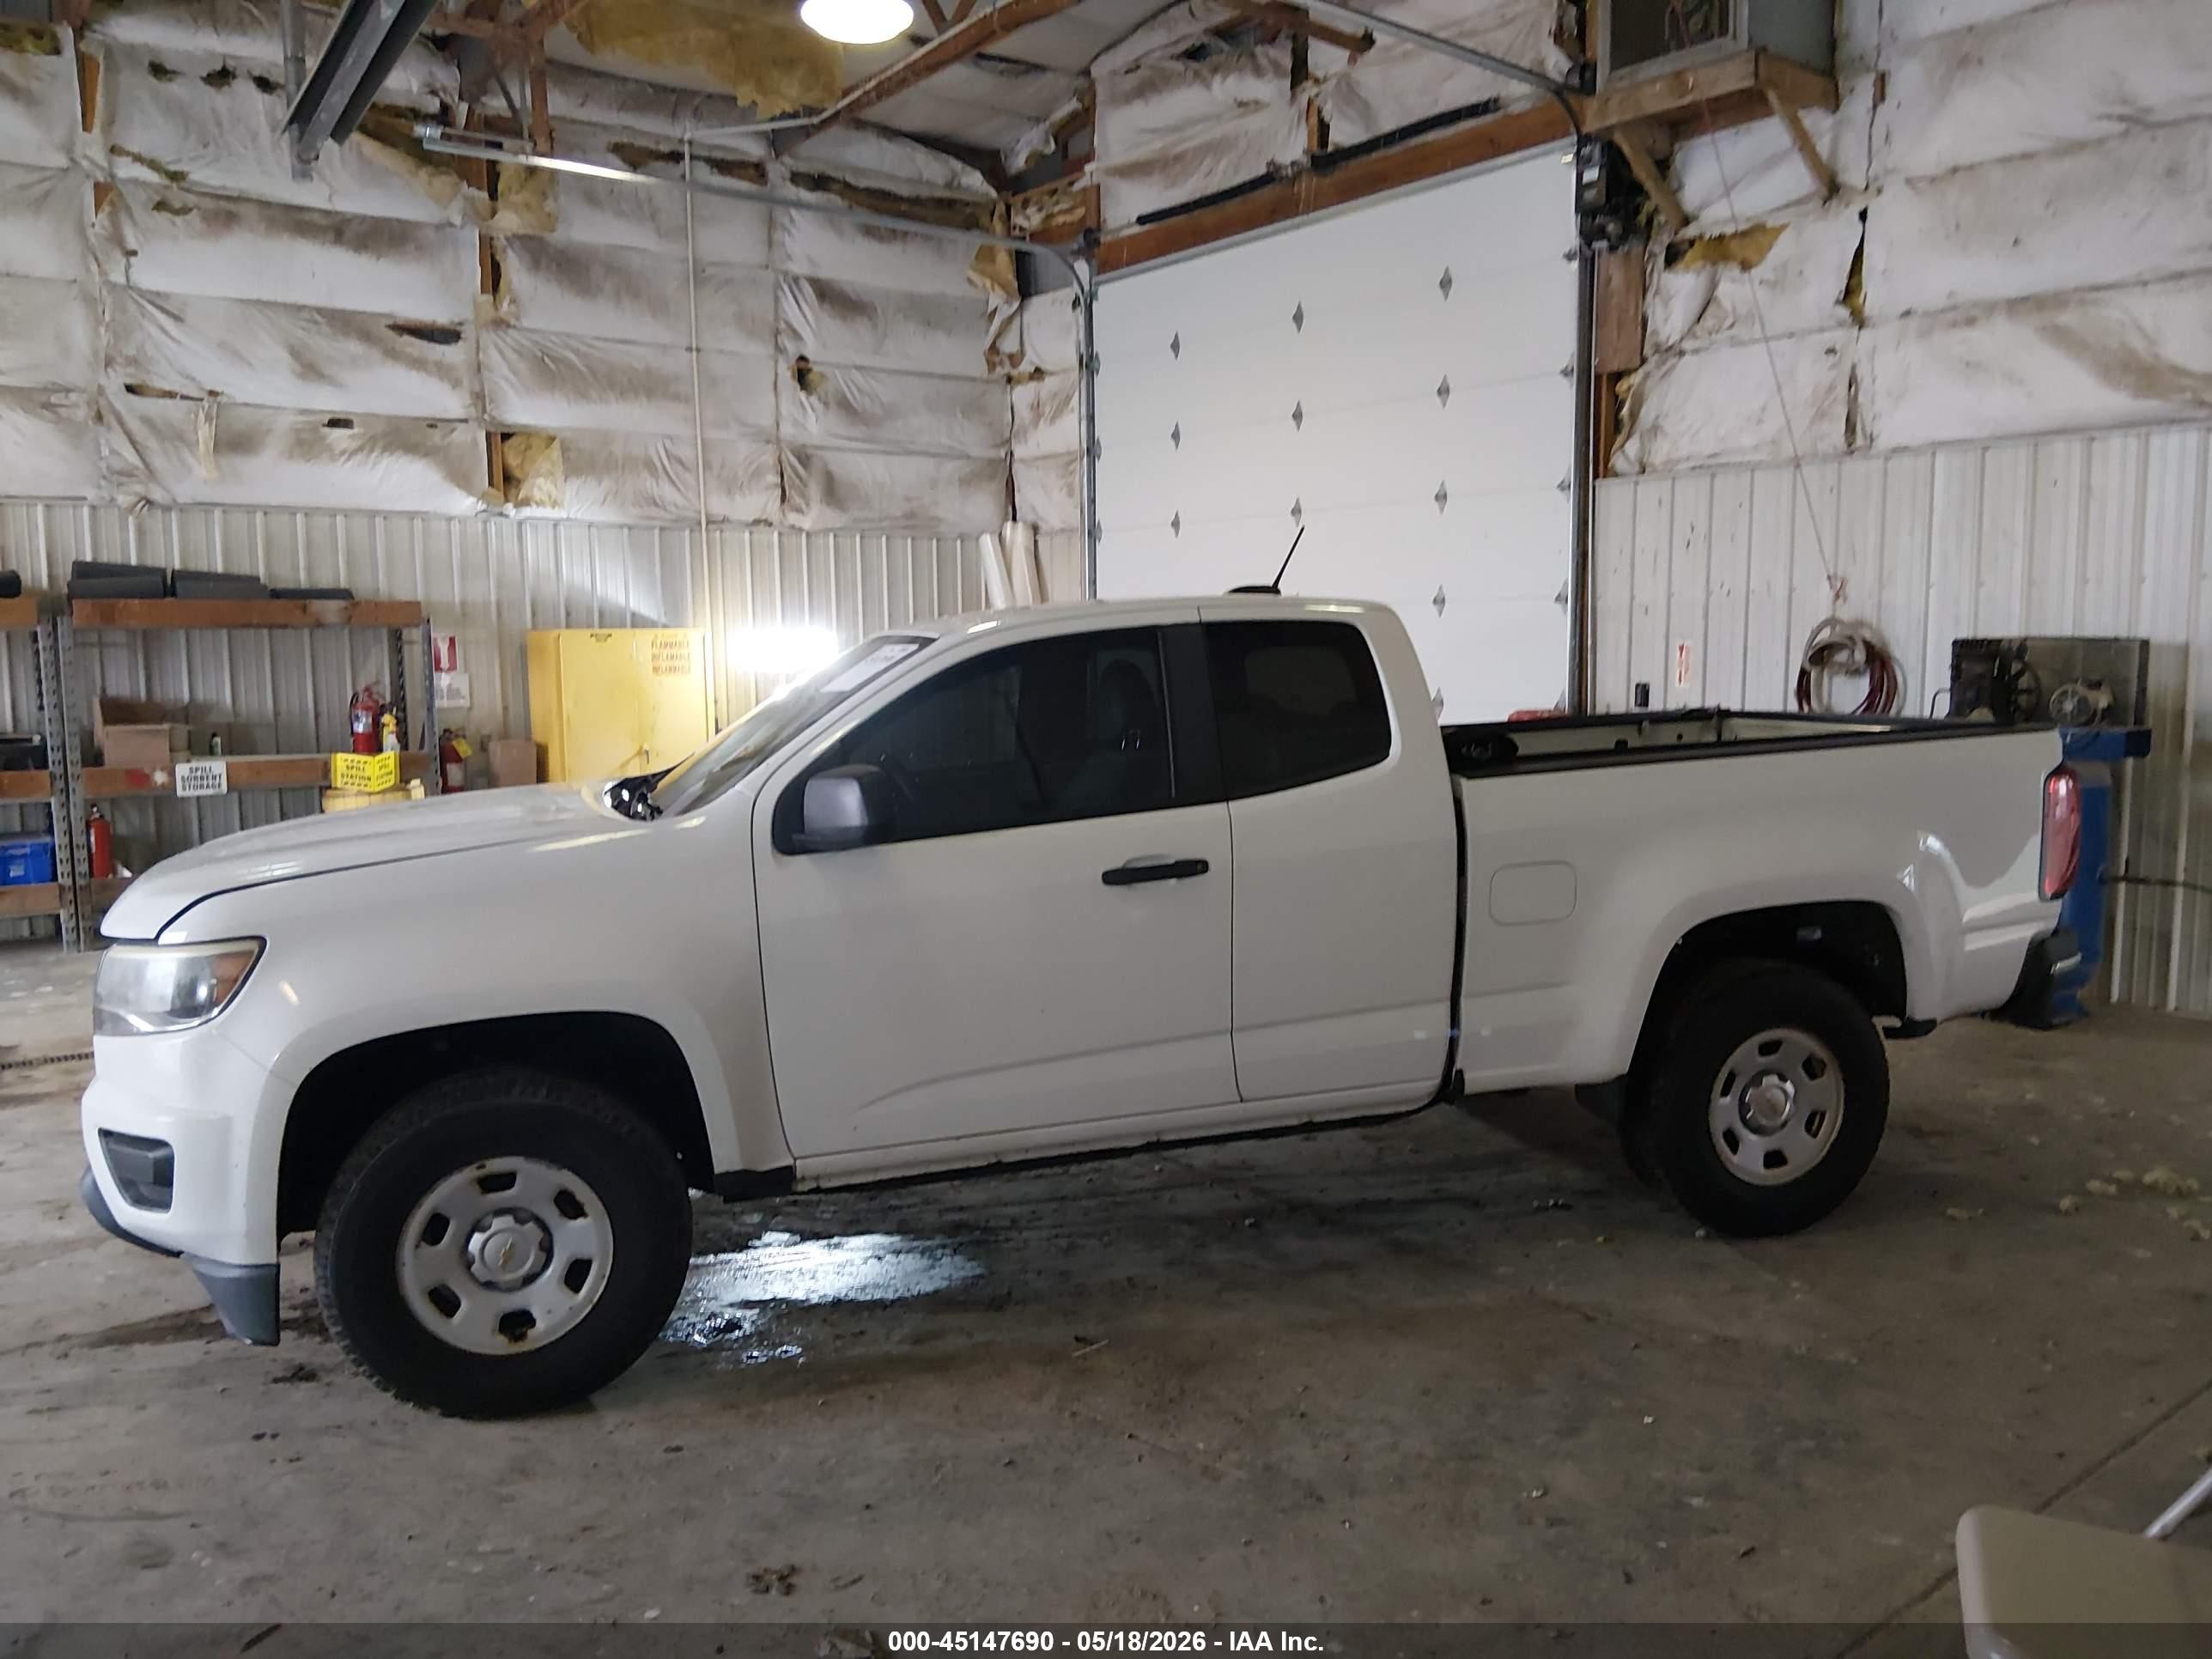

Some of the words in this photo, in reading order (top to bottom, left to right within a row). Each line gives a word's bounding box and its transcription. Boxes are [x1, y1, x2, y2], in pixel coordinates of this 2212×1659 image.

[652, 639, 690, 649] FLAMMABLE
[189, 765, 212, 774] SPILL
[345, 764, 365, 773] SPILL
[181, 774, 222, 783] SORBENT
[341, 773, 372, 781] STATION
[181, 782, 221, 792] STORAGE
